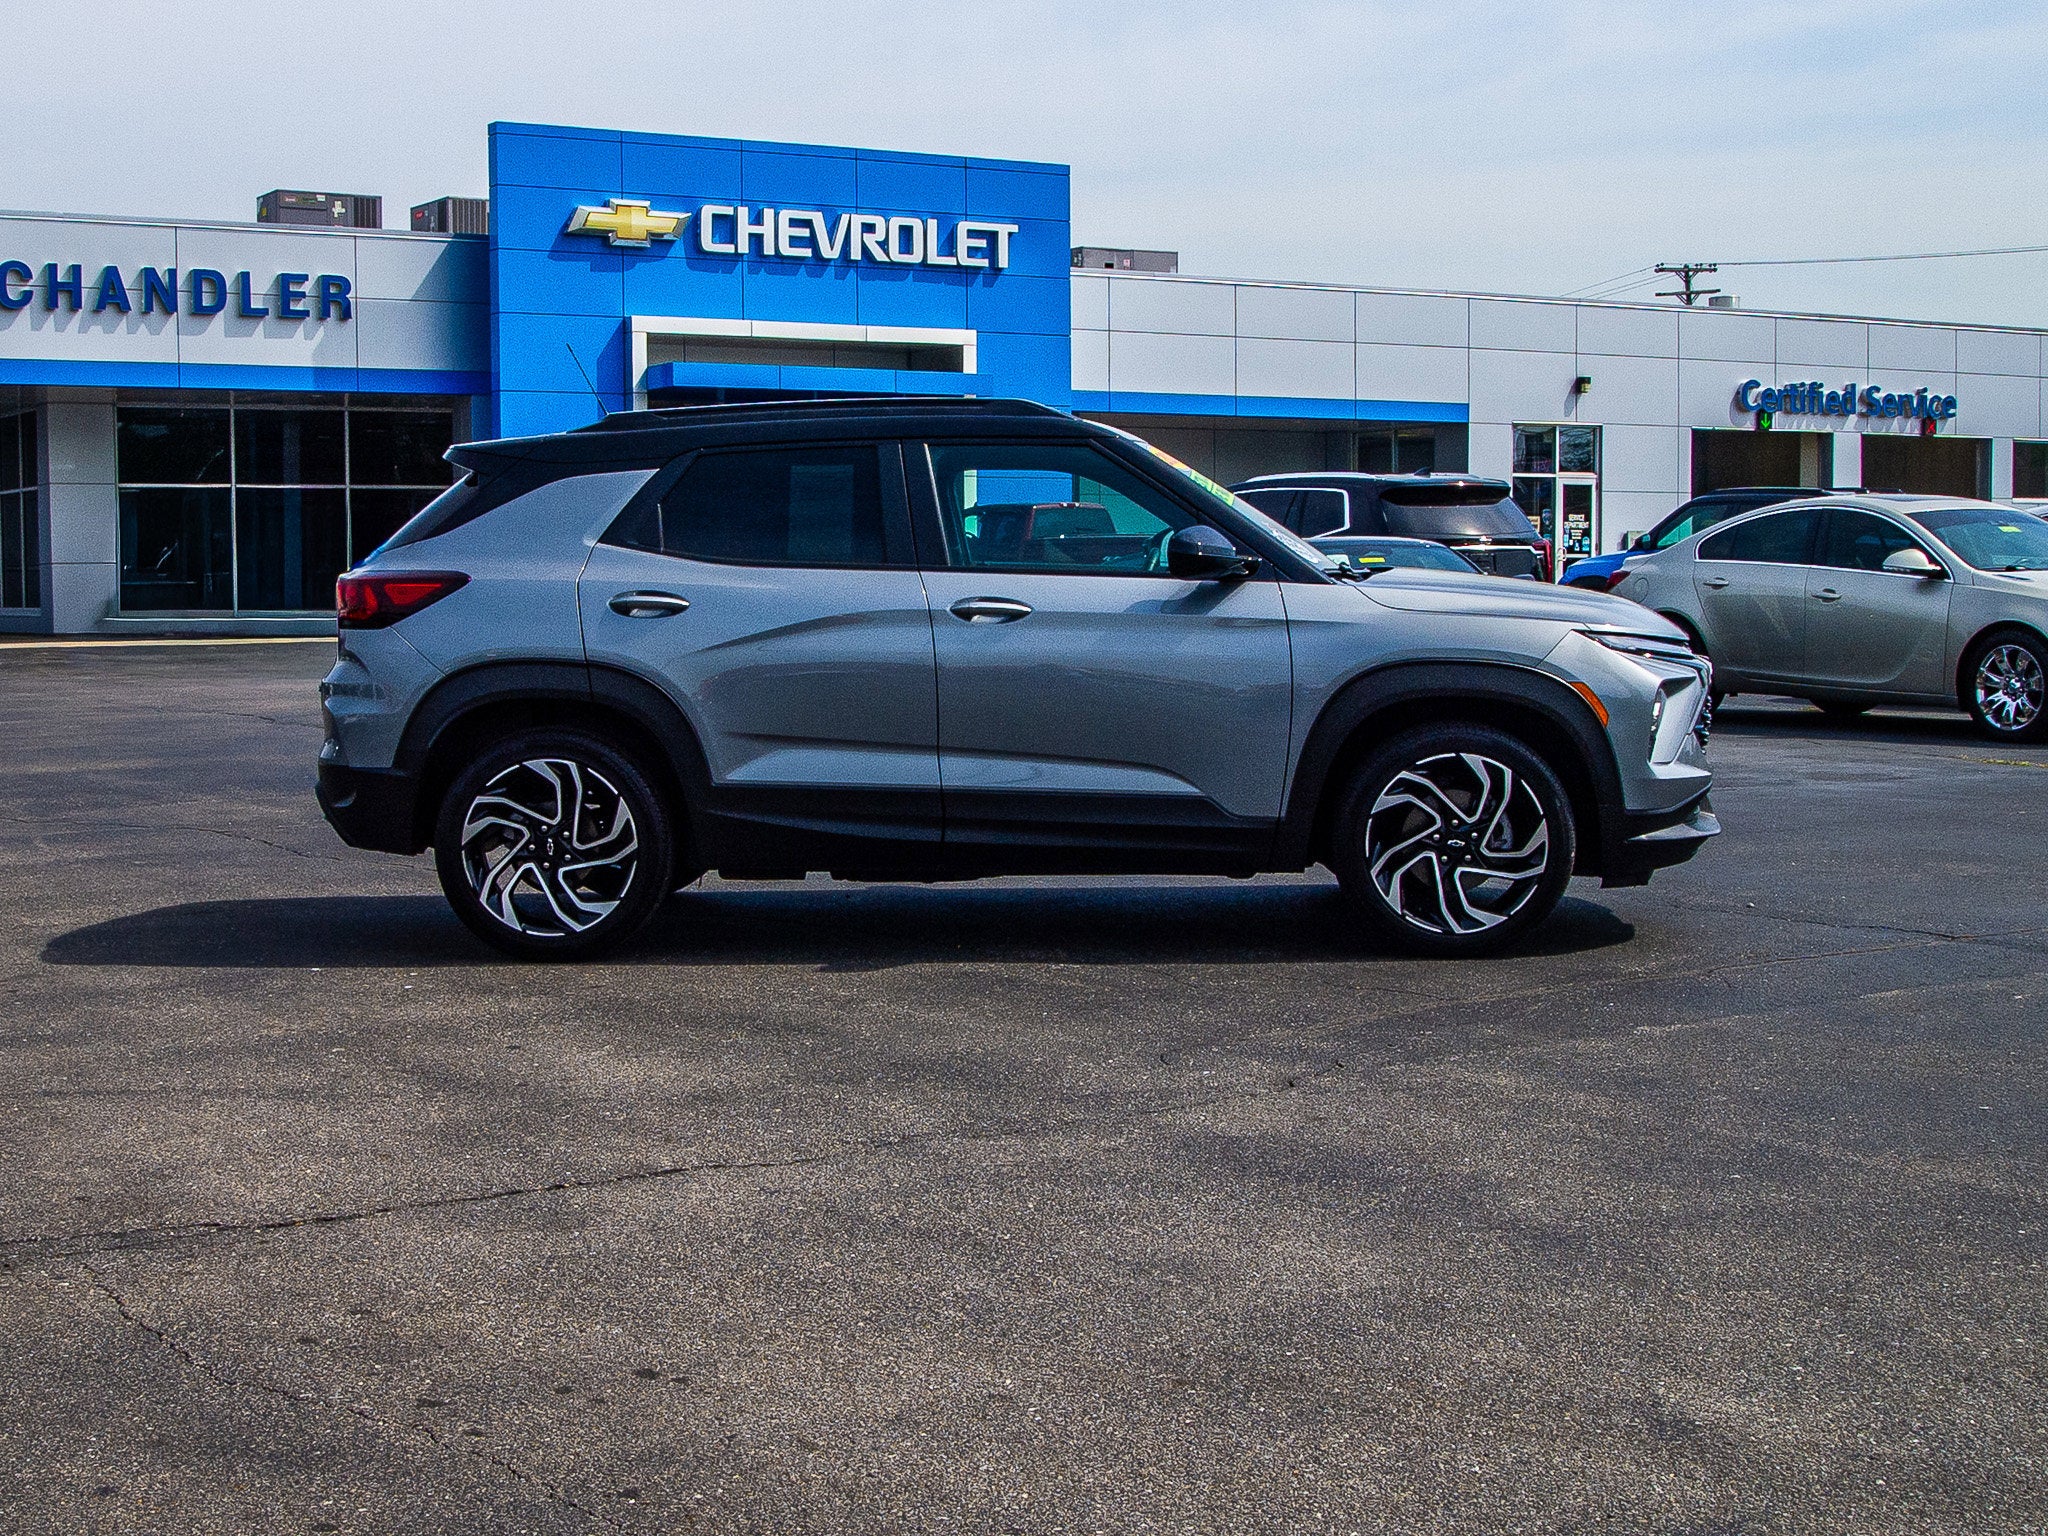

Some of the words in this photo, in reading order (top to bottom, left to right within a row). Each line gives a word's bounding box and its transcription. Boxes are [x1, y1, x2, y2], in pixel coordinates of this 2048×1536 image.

[700, 204, 1019, 268] CHEVROLET
[0, 259, 352, 320] CHANDLER
[1740, 379, 1857, 414] Certified
[1865, 385, 1957, 419] Service
